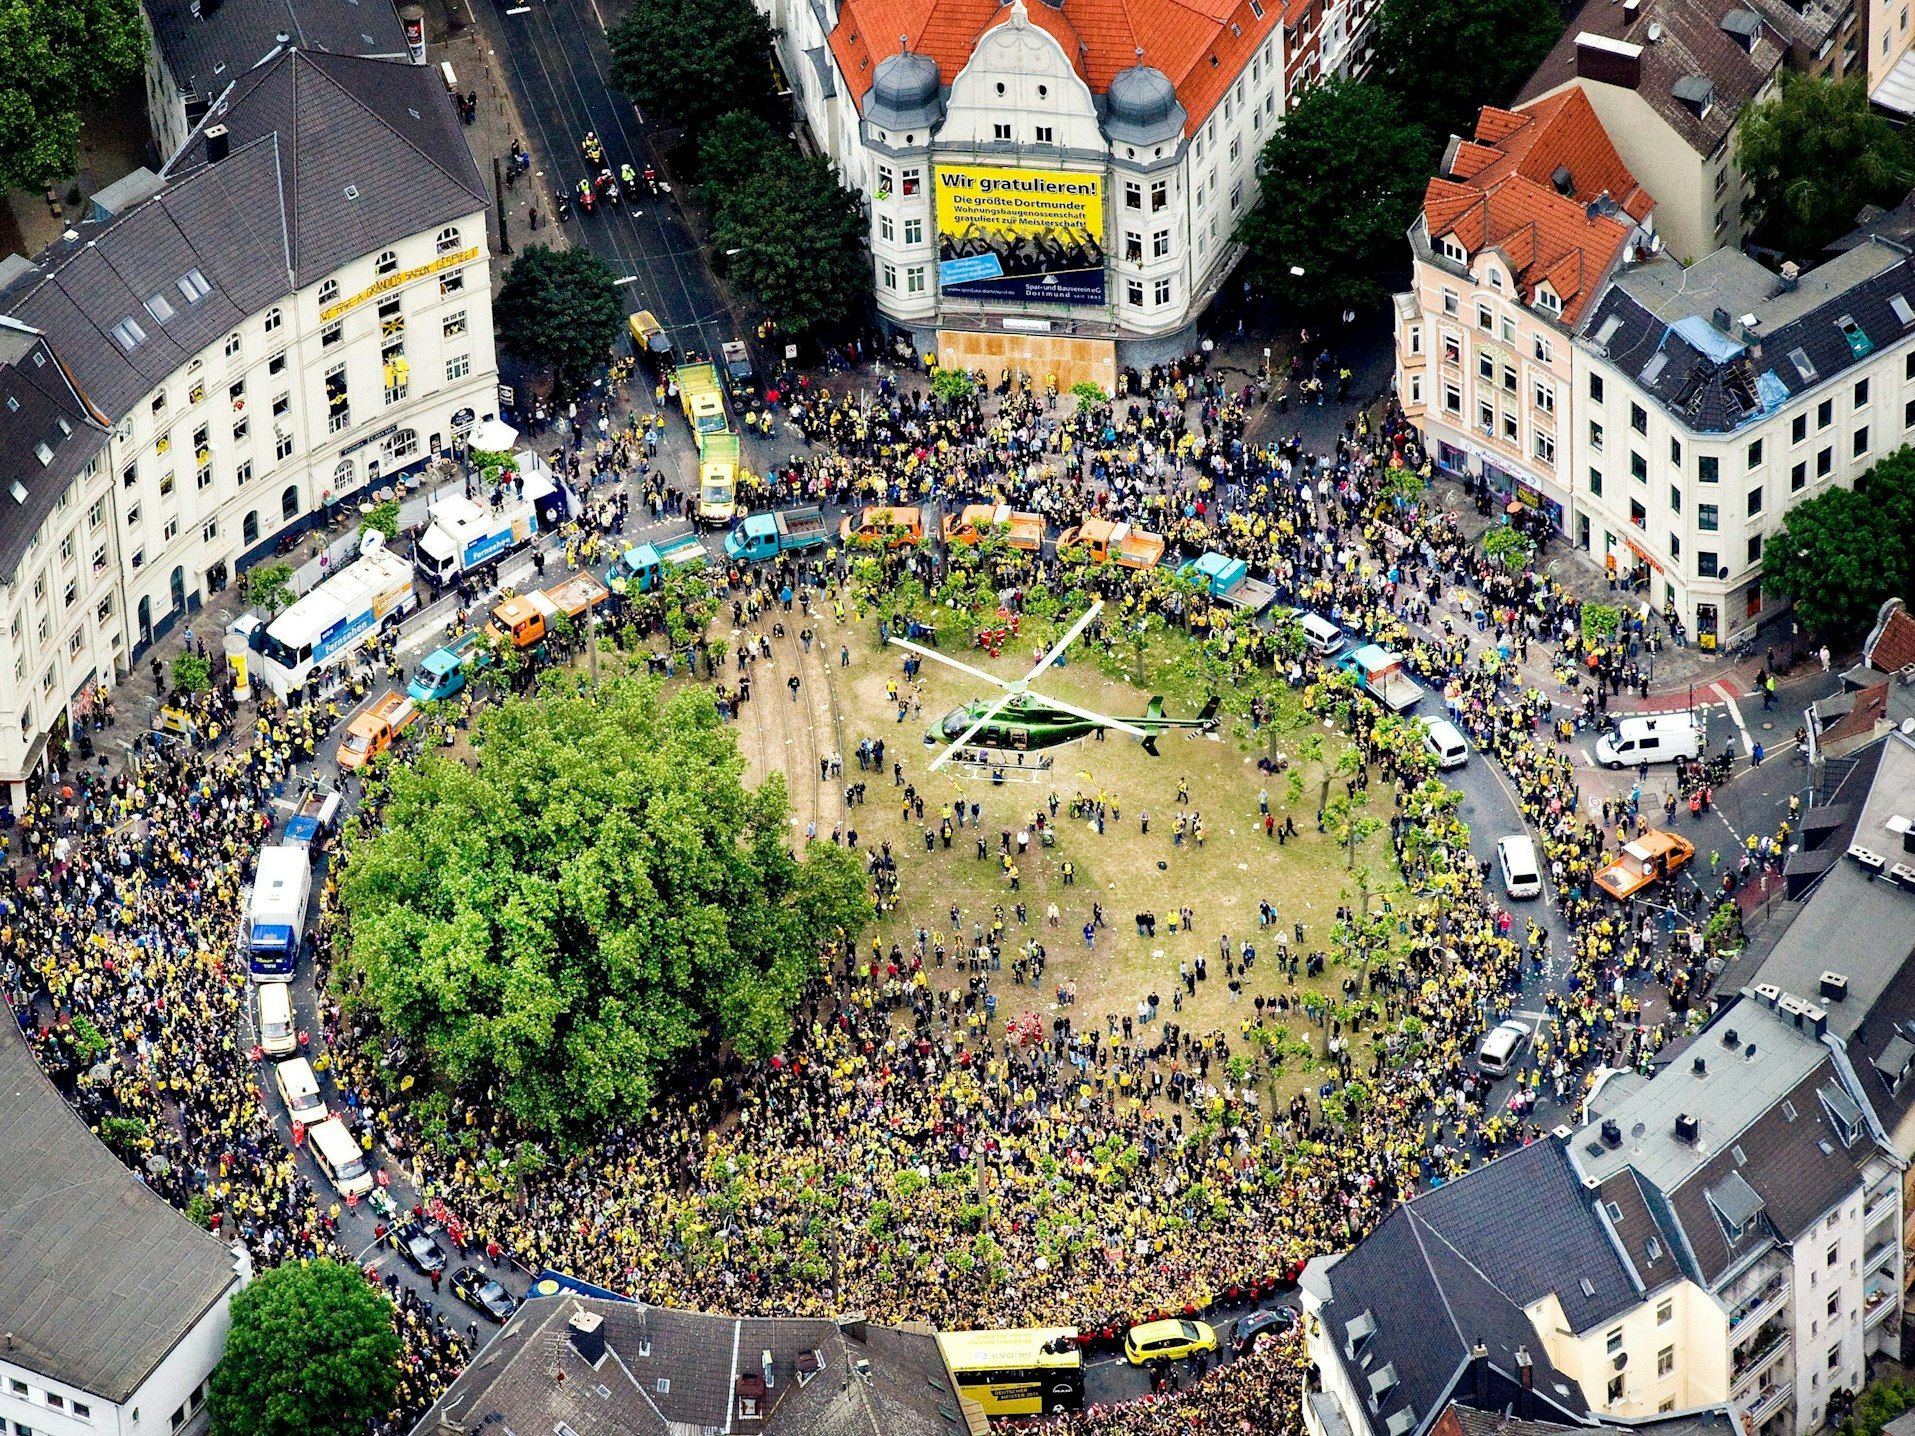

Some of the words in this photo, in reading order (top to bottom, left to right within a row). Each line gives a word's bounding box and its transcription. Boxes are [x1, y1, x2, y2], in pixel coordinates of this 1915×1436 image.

[941, 173, 975, 188] Wir
[980, 178, 1097, 196] gratulieren!
[954, 195, 973, 204] Die
[974, 197, 1013, 207] größte
[1014, 200, 1086, 210] Dortmunder
[954, 205, 1086, 219] Wohnungsbaugenossenschaft
[954, 215, 1000, 223] gratuliert
[473, 537, 511, 560] Fernsehen
[325, 621, 367, 654] Fernsehen
[994, 1388, 1028, 1396] DEUTSCHER
[1000, 1392, 1026, 1400] MEISTER
